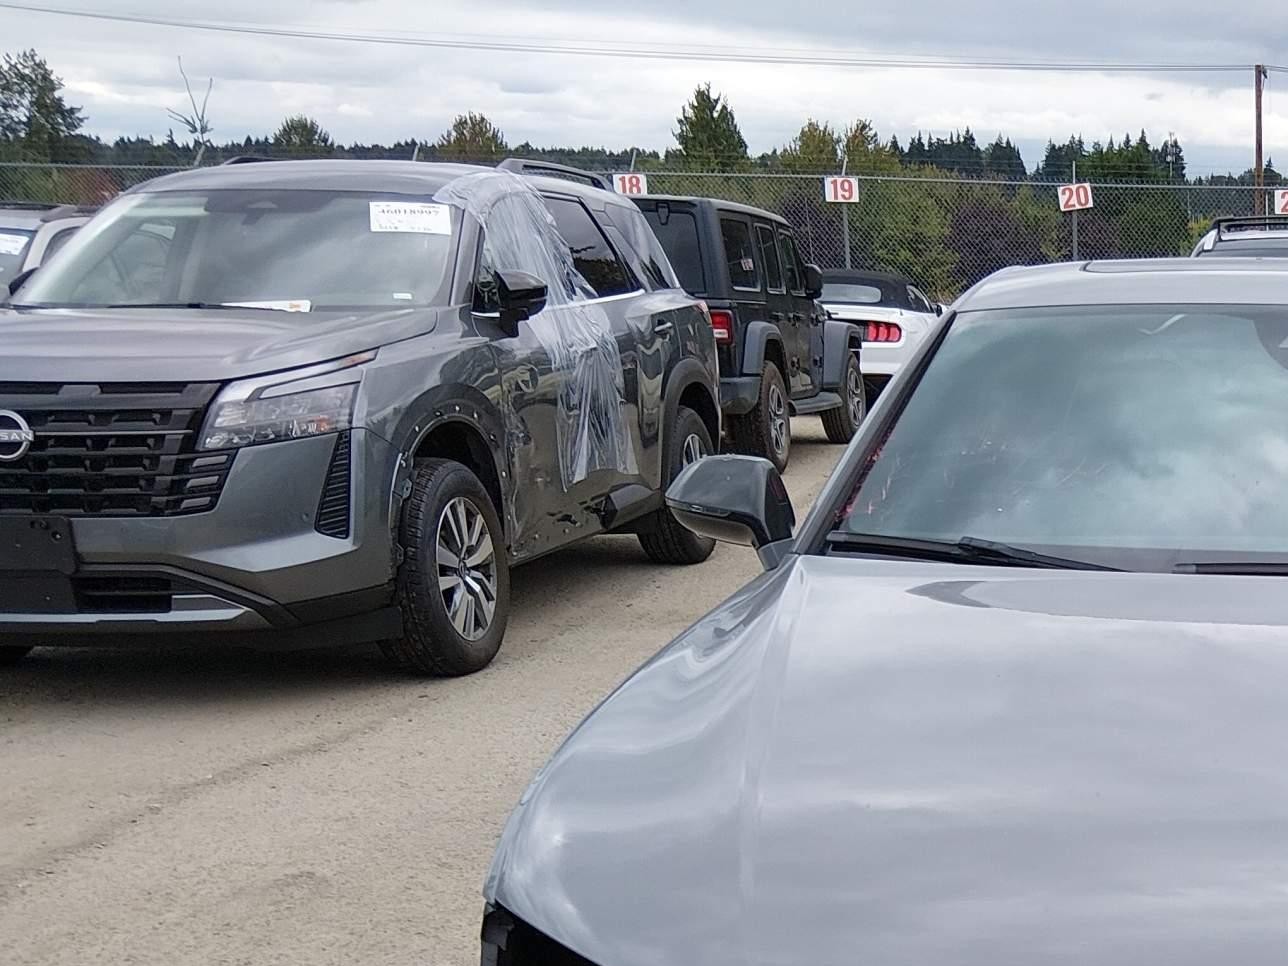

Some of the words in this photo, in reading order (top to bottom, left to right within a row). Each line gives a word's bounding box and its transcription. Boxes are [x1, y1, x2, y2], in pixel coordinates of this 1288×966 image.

[618, 175, 642, 194] 18
[830, 178, 854, 201] 19
[1061, 185, 1090, 210] 20
